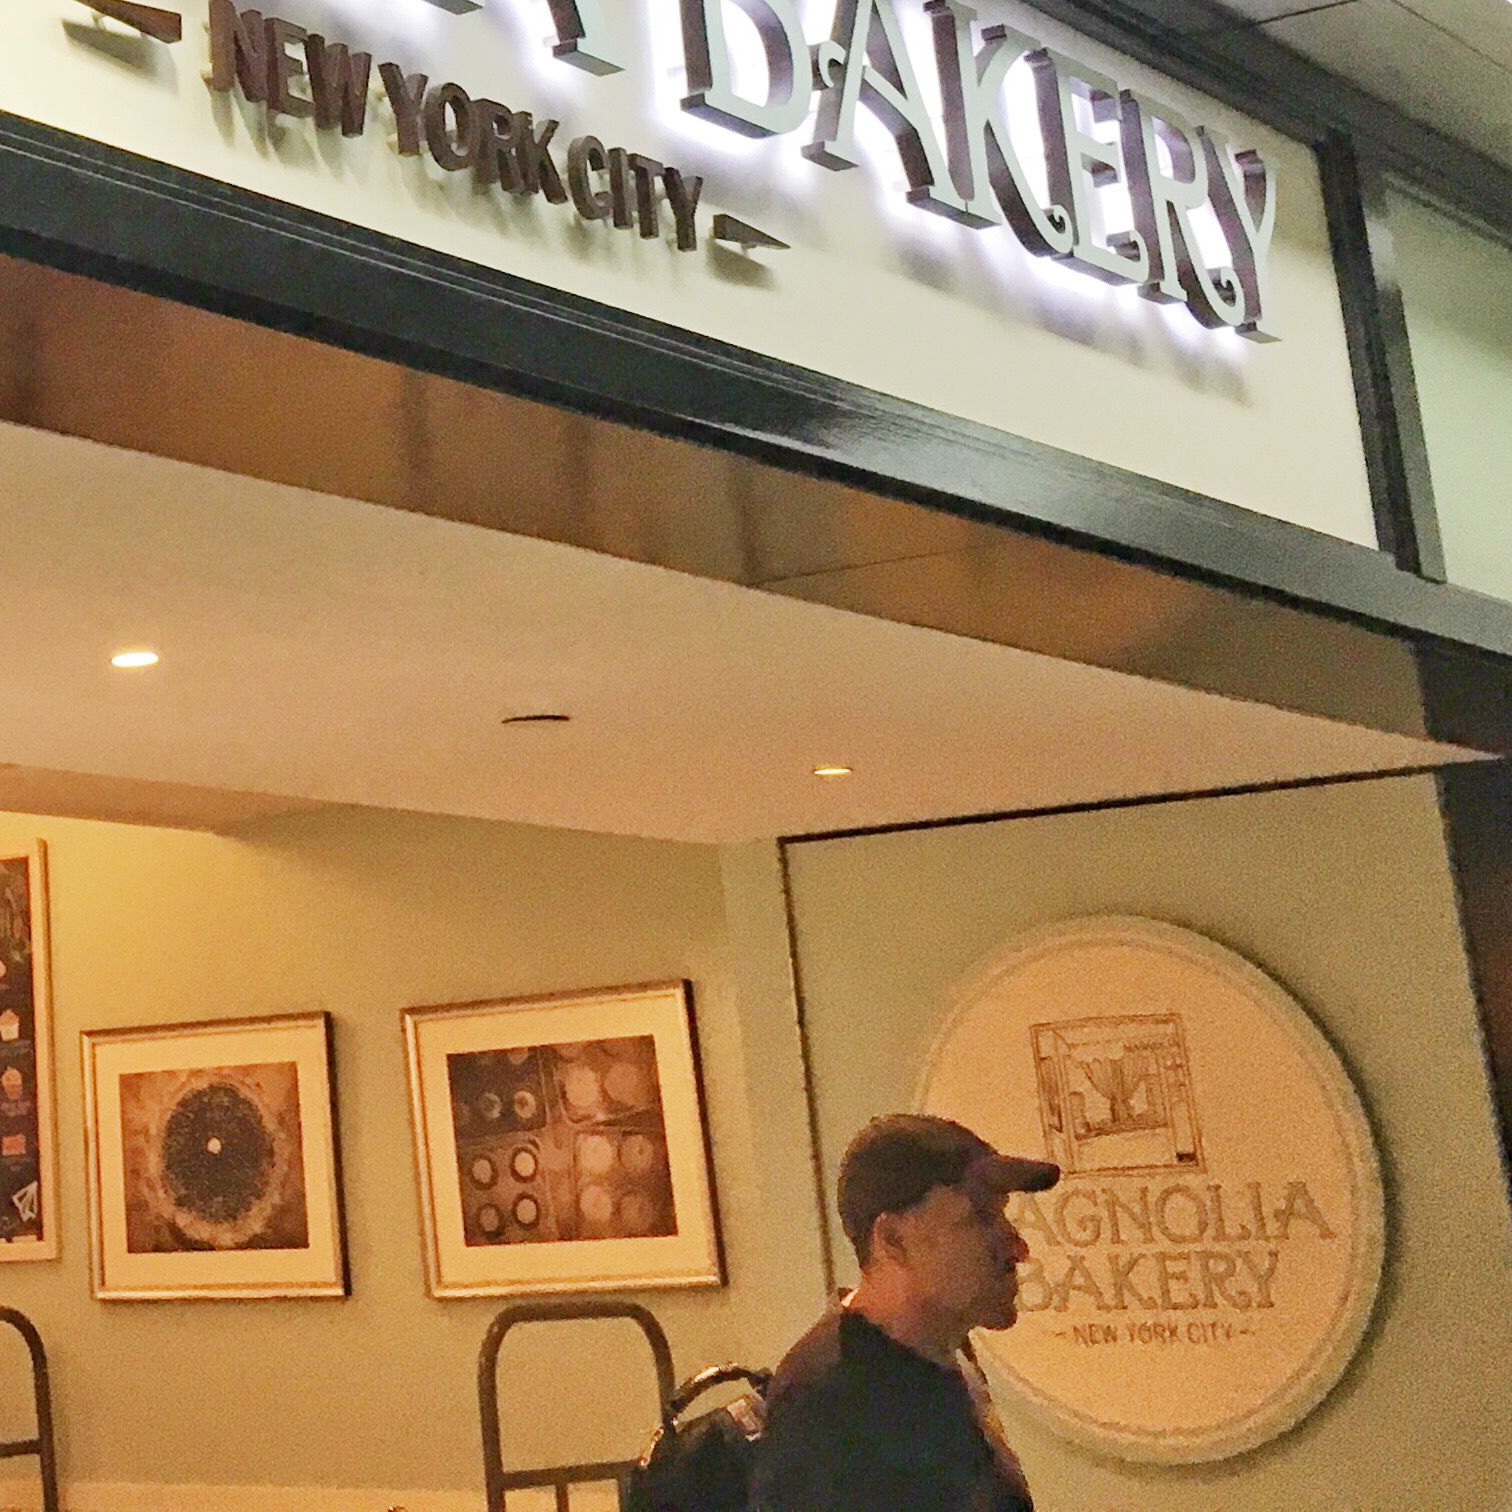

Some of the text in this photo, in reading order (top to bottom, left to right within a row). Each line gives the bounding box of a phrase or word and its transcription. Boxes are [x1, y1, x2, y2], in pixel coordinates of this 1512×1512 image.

[376, 61, 569, 205] YORK
[565, 134, 705, 252] CITY
[1008, 1180, 1337, 1248] AGNOLIA
[1014, 1249, 1278, 1312] BAKERY
[1072, 1320, 1233, 1347] NEW YORK CITY
